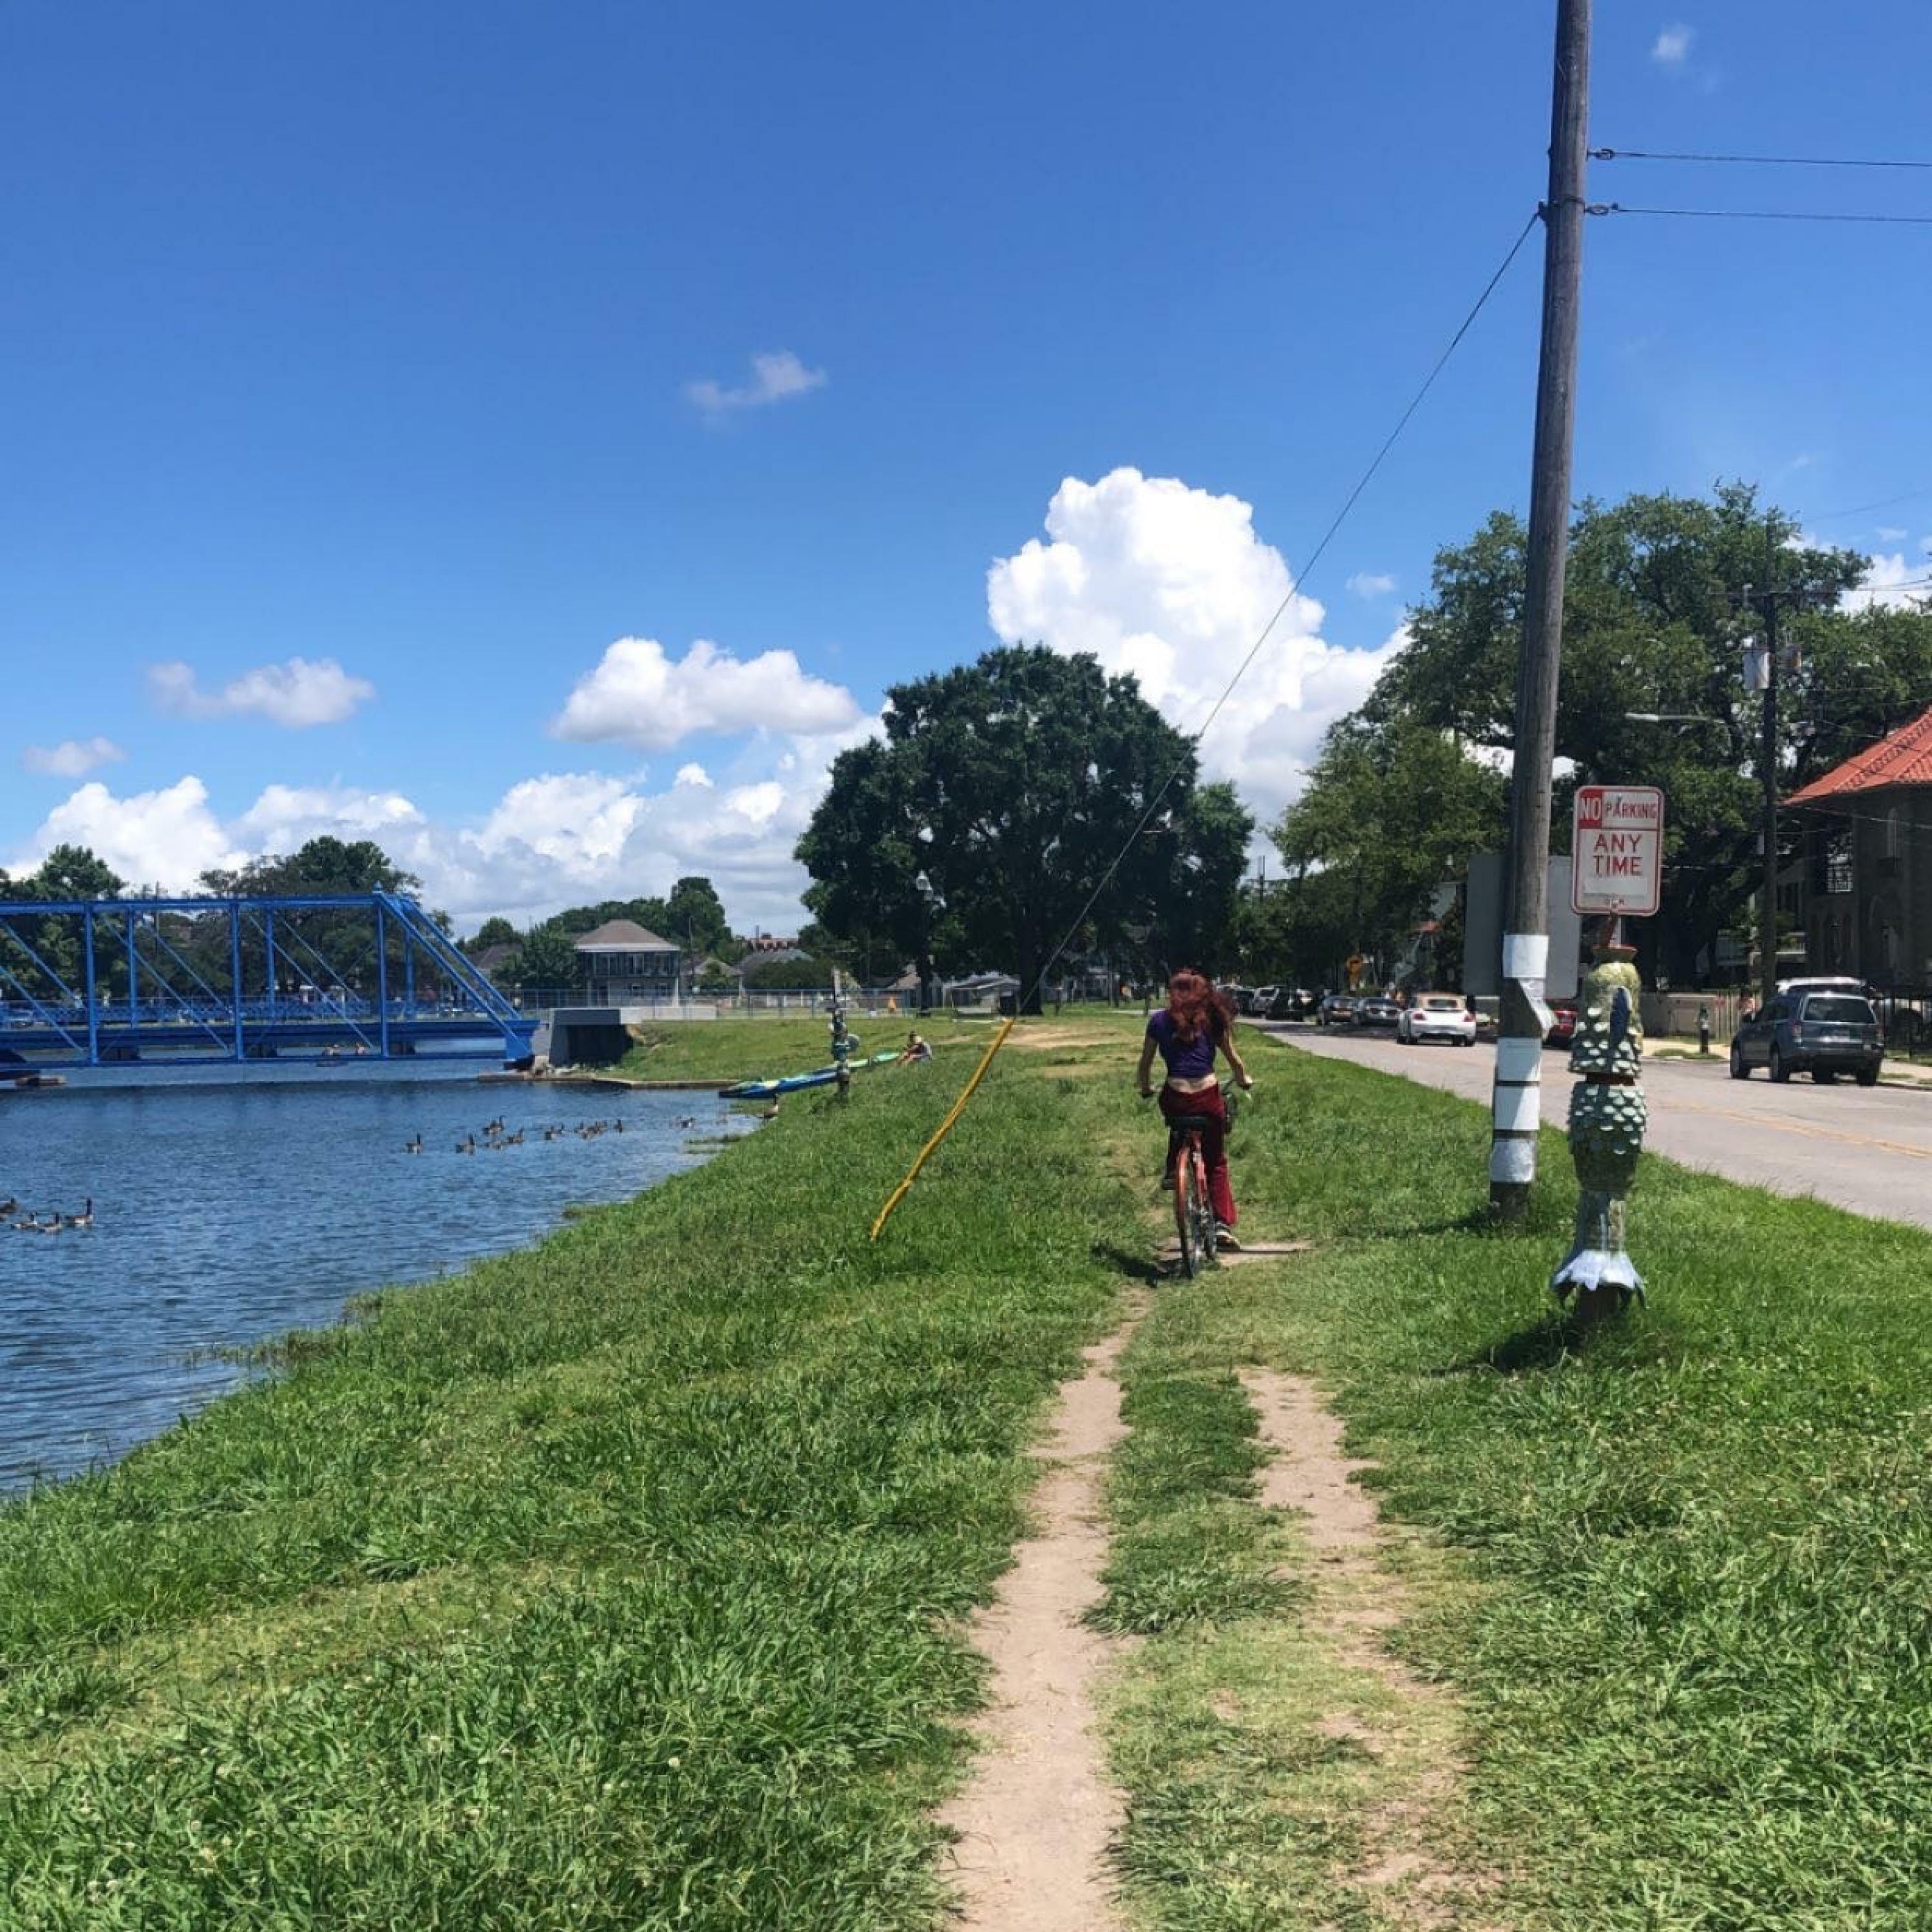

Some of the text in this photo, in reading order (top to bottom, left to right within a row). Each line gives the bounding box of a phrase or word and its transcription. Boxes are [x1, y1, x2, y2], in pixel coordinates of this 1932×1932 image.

[1580, 797, 1658, 820] NO PARKING
[1593, 834, 1642, 853] ANY
[1593, 855, 1643, 876] TIME
